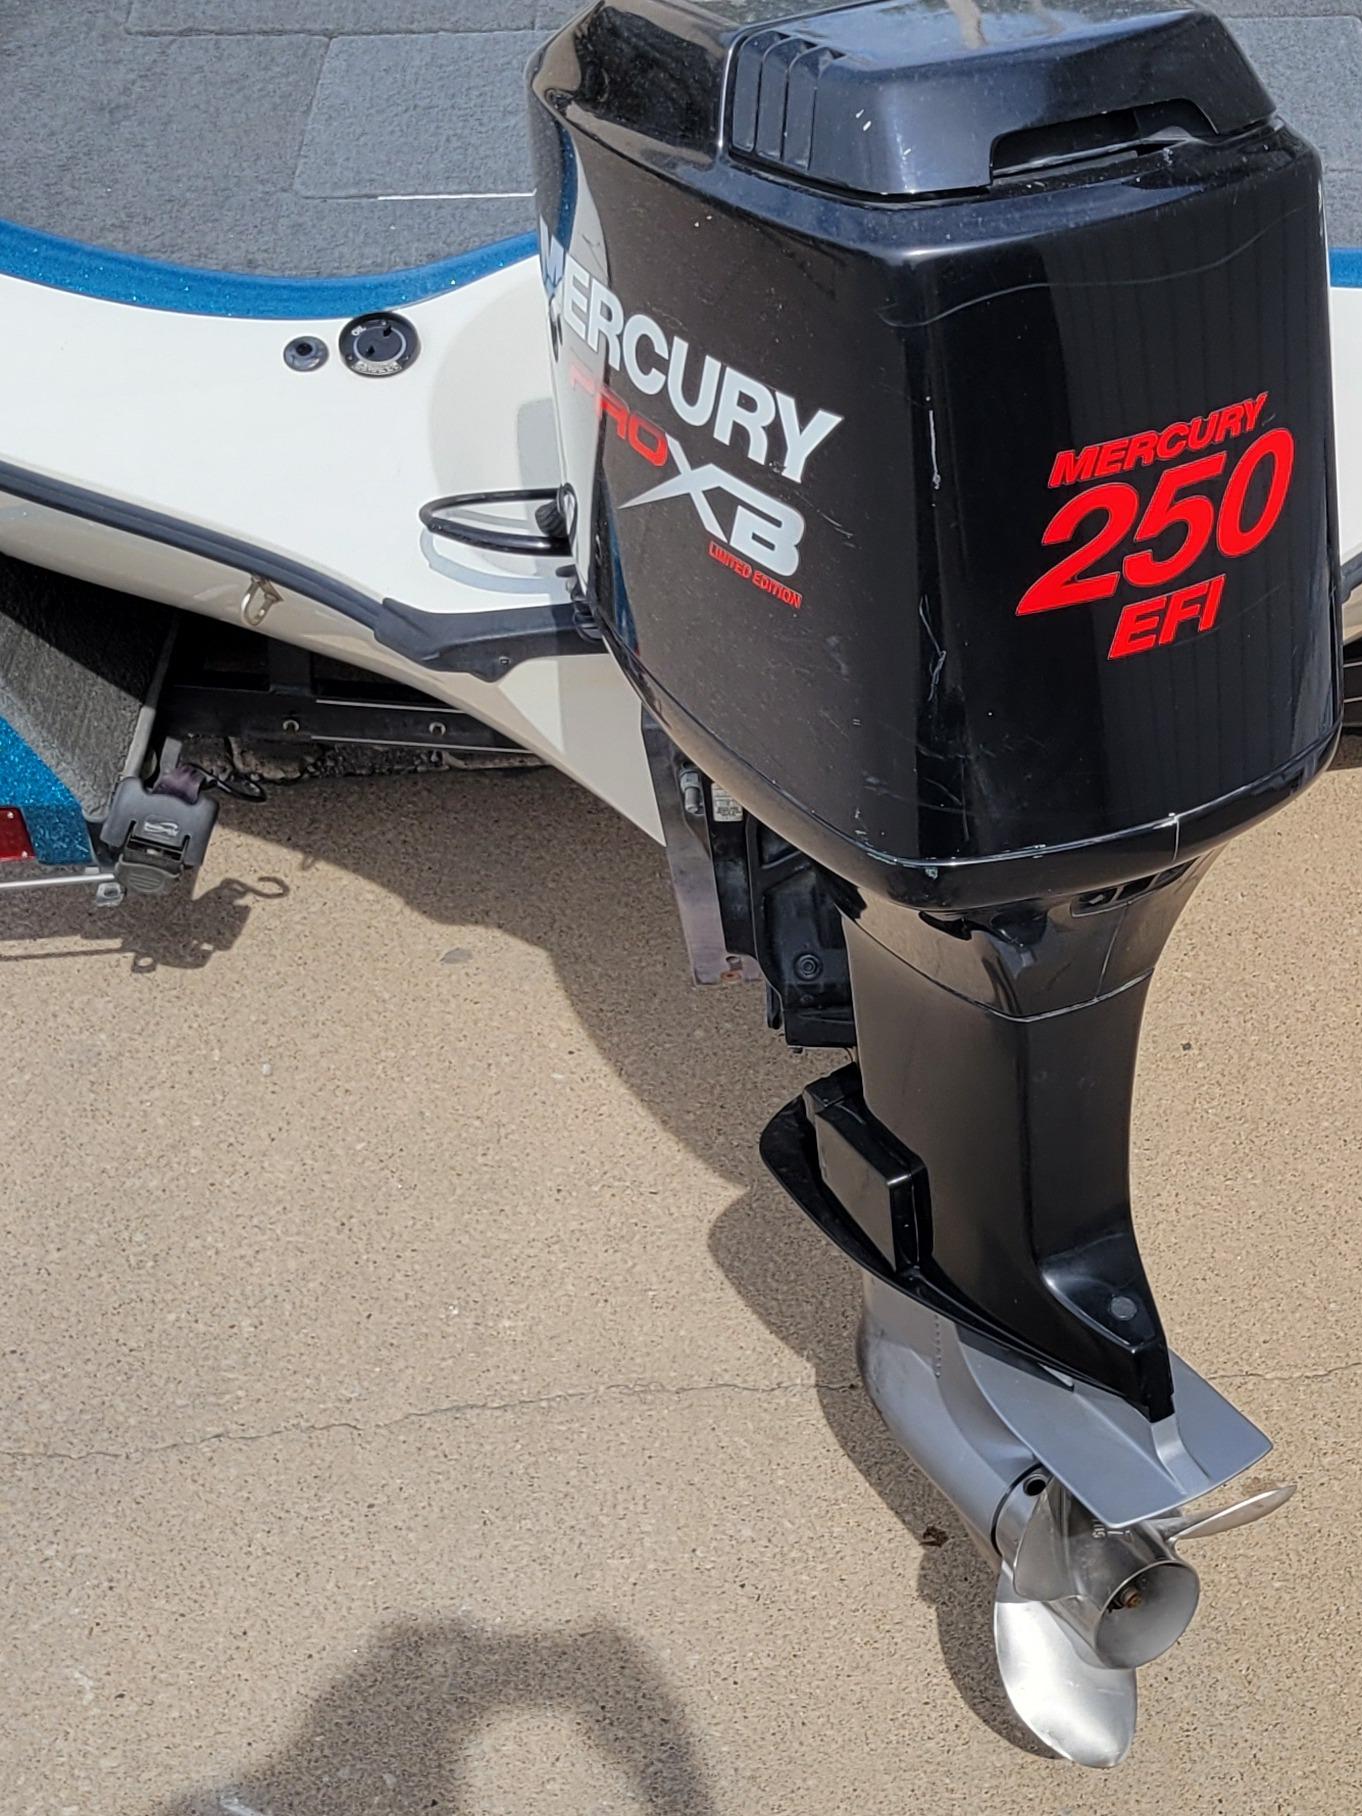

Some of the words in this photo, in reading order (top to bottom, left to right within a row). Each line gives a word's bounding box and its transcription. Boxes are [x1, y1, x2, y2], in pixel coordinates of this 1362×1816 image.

[1047, 391, 1269, 489] MERCURY
[1016, 427, 1295, 616] 250
[708, 540, 752, 578] LIMITED
[752, 570, 802, 609] EDITION
[1108, 574, 1226, 660] EFI
